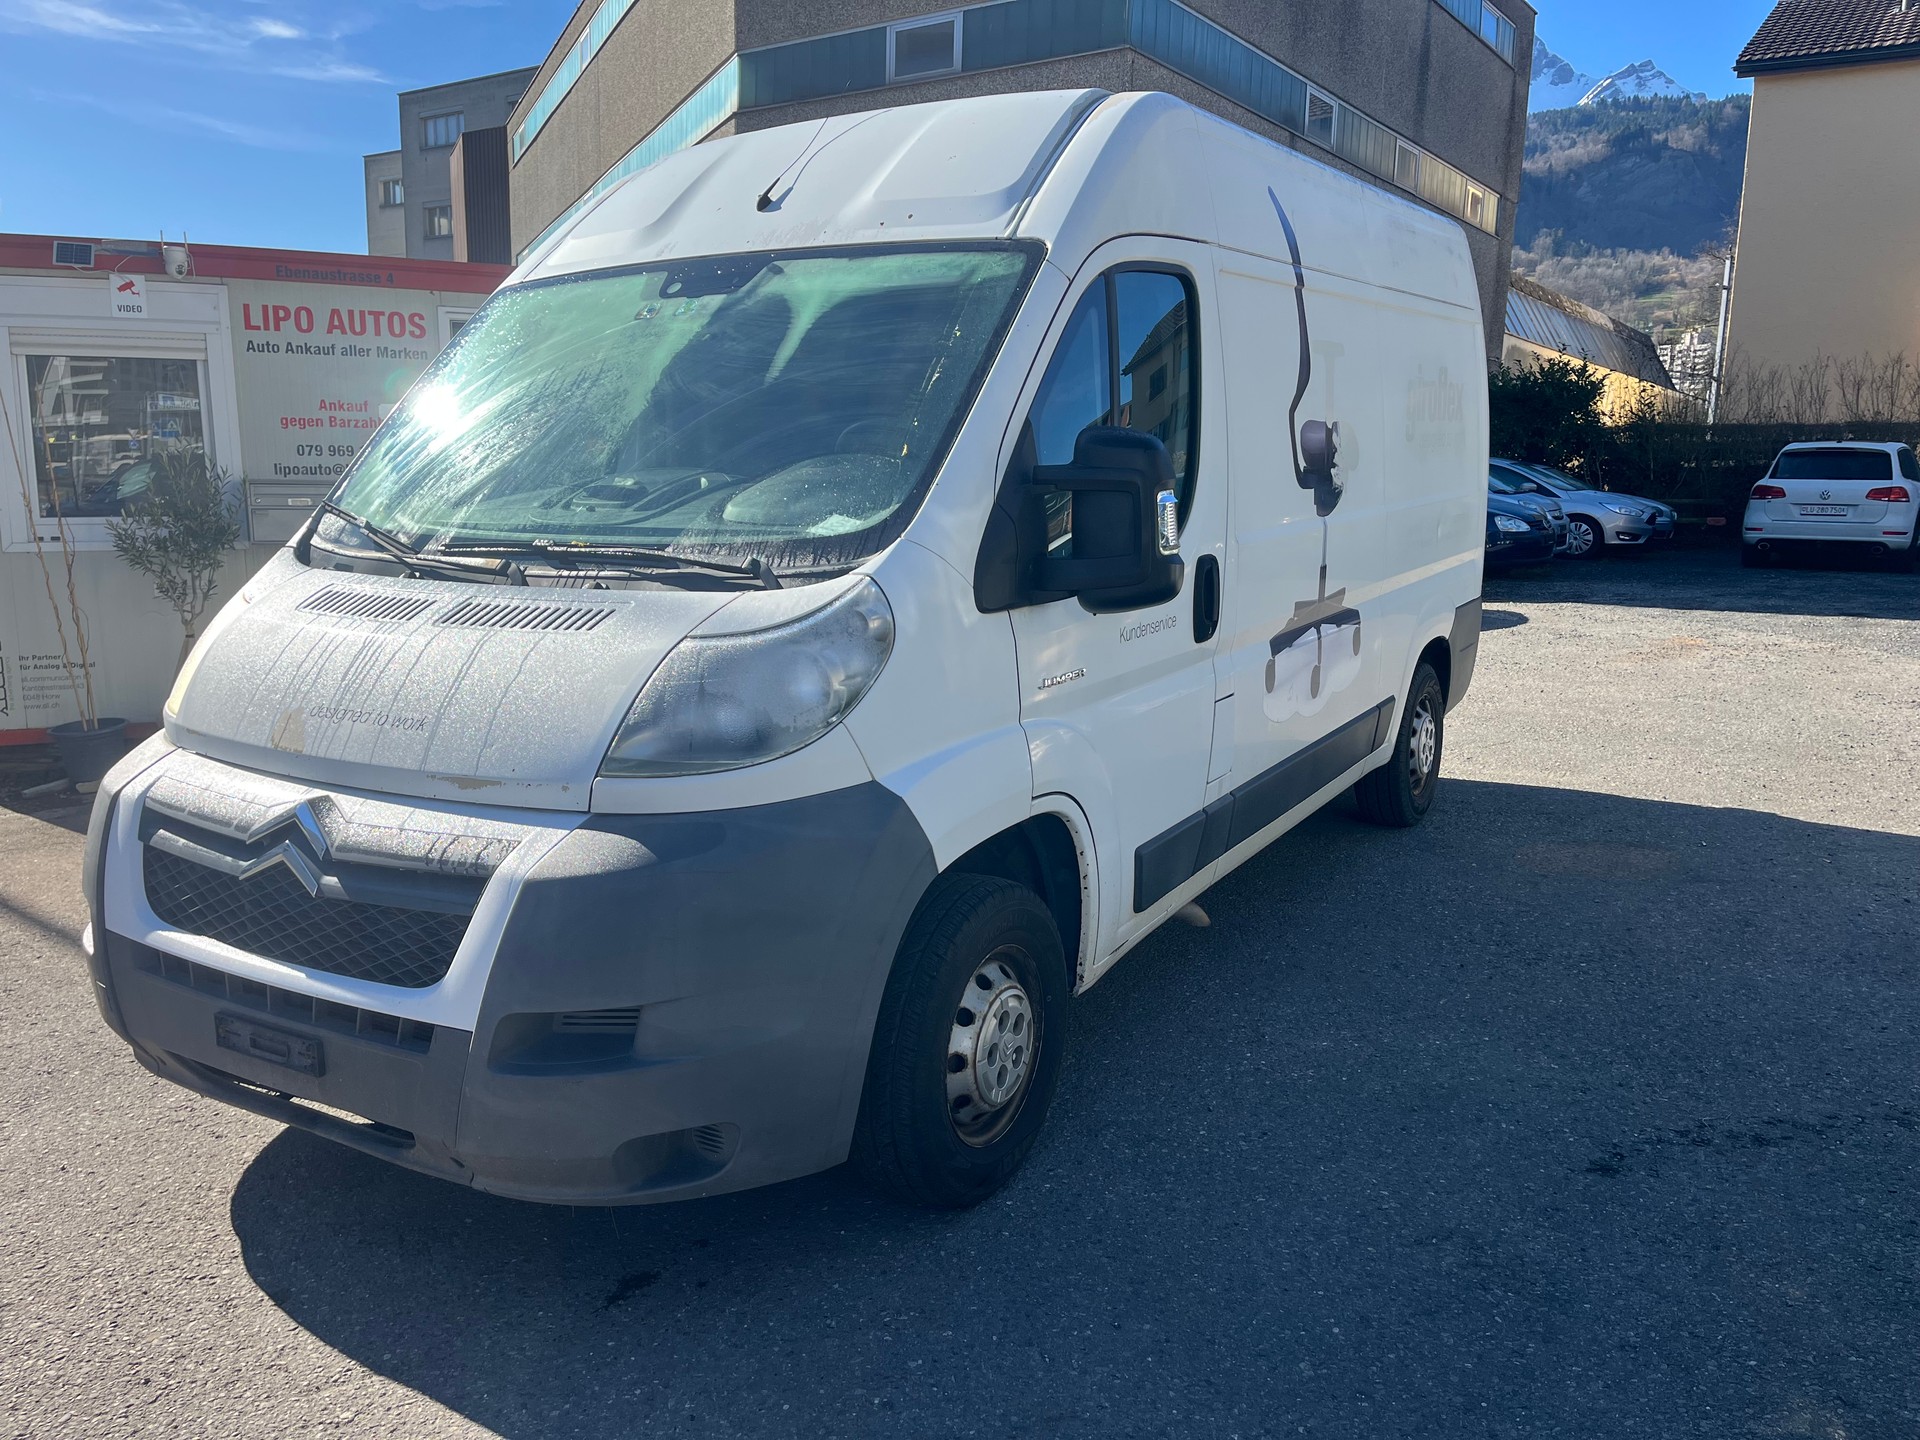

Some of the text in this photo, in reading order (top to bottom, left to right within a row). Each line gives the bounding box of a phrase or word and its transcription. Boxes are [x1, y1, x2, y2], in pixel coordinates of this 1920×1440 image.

[275, 264, 395, 285] Ebenaustrasse 4
[116, 304, 143, 313] VIDEO
[242, 303, 427, 339] LIPO AUTOS
[246, 340, 428, 360] Auto Ankauf aller Marken
[318, 399, 369, 412] Ankauf
[279, 415, 385, 430] gegen Barzahl
[296, 444, 323, 457] 079
[328, 444, 354, 458] 969
[1119, 614, 1177, 644] Kundenservice
[70, 661, 96, 669] Digal
[1037, 667, 1087, 690] JUMPER
[309, 702, 428, 732] designed to work
